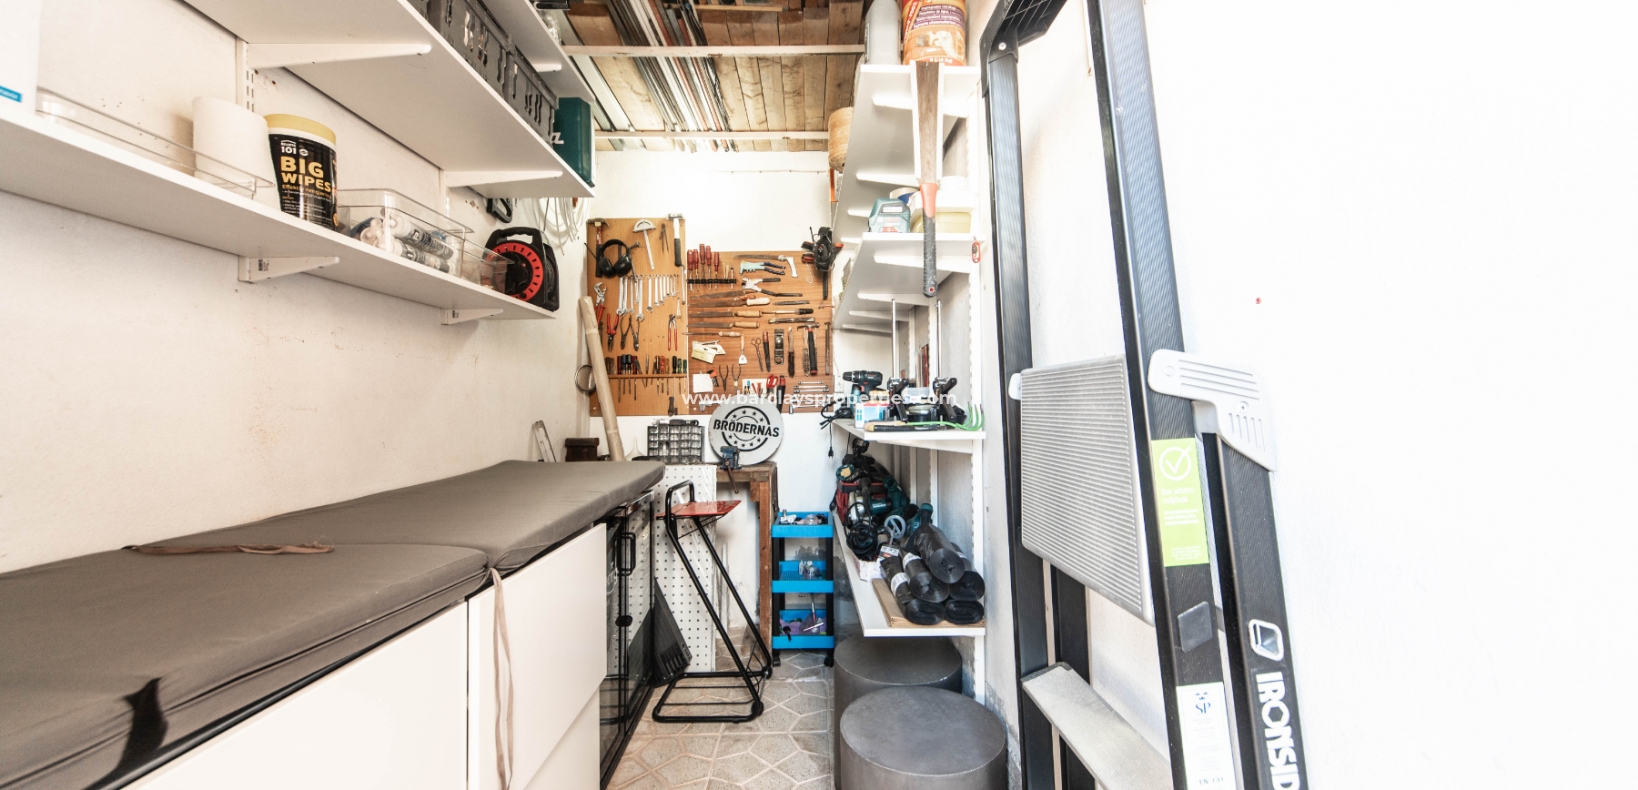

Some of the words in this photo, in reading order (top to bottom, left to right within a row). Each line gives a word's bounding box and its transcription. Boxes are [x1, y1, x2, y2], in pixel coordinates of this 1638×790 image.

[281, 146, 297, 155] 101
[281, 156, 324, 179] BIG
[281, 172, 331, 193] WIPES
